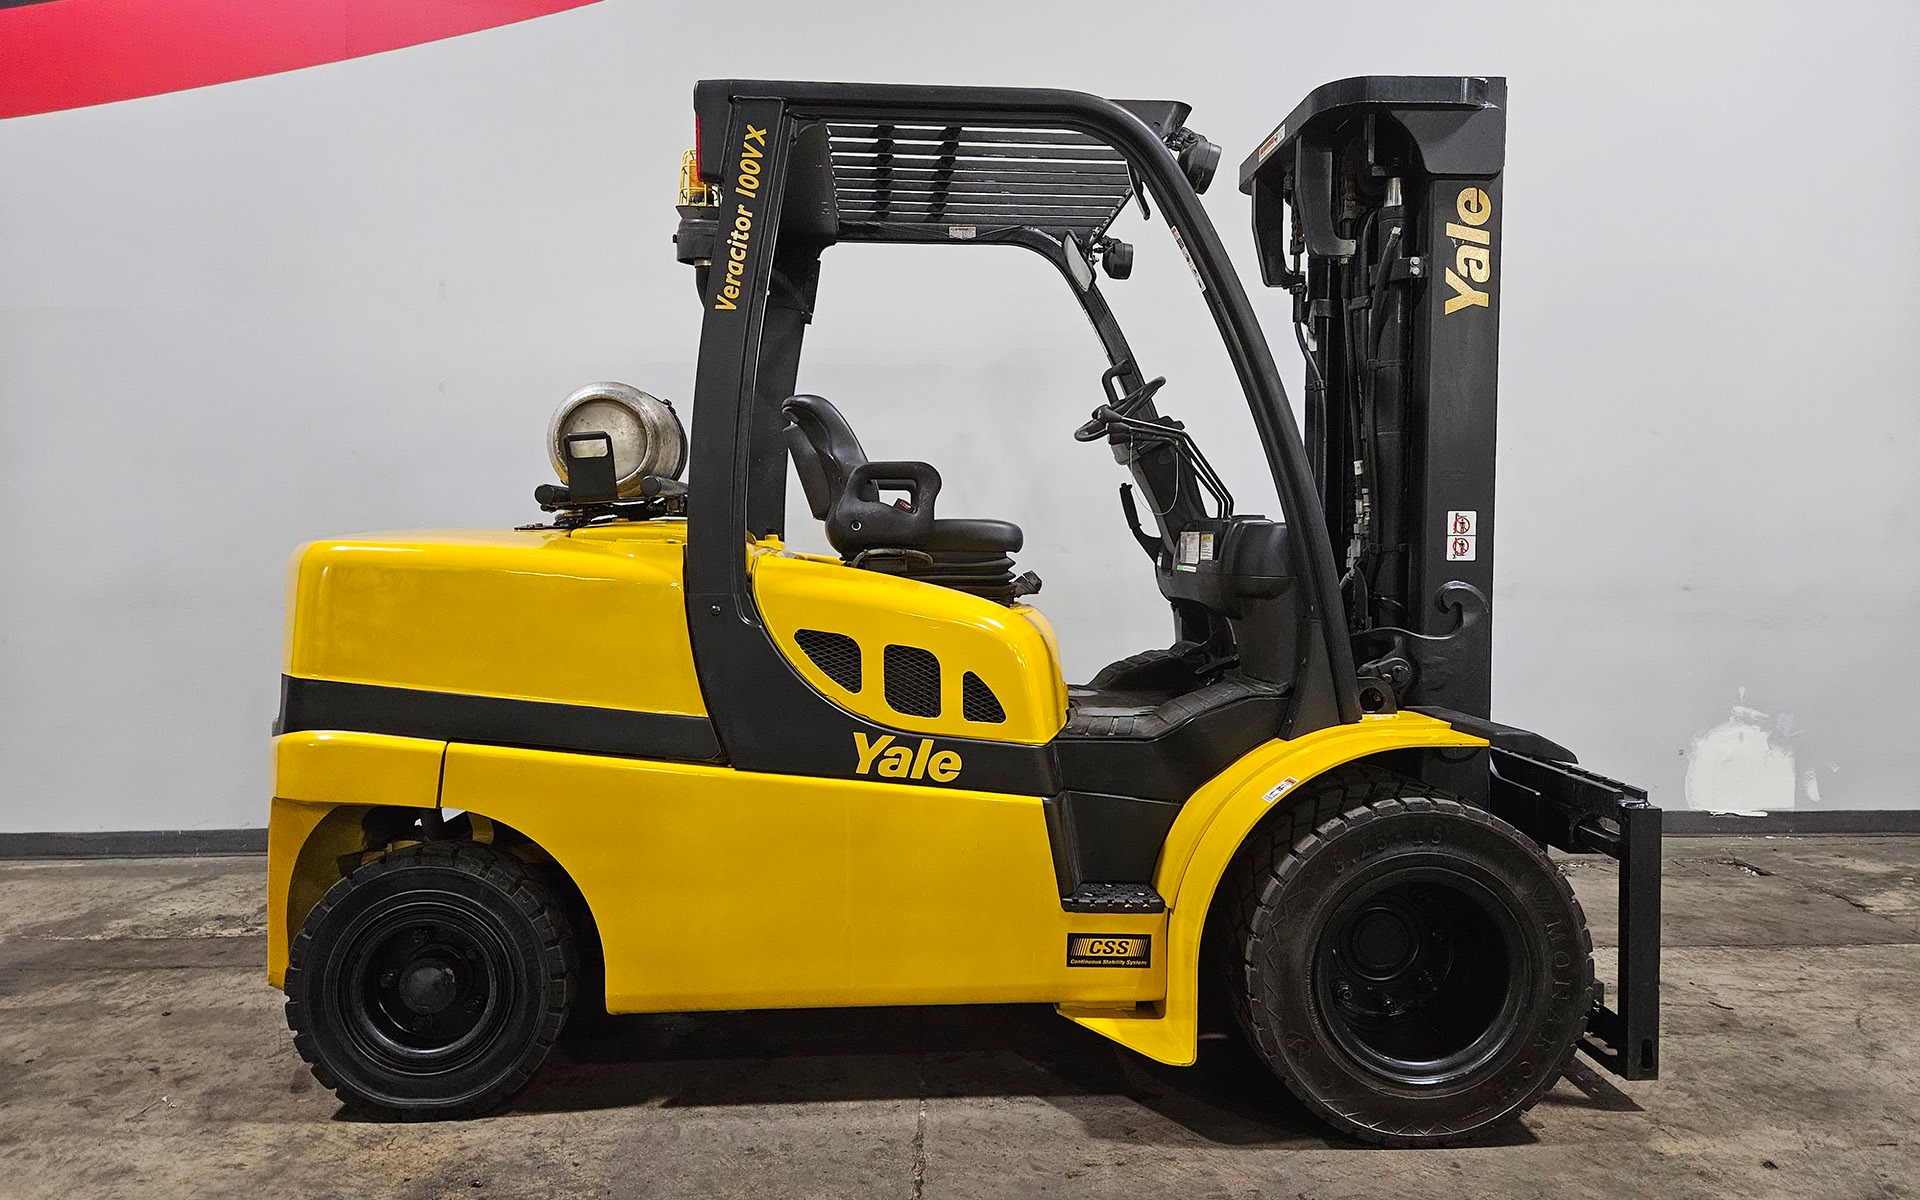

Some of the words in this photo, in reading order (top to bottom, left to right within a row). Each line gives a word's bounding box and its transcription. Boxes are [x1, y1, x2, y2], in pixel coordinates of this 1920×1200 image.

[714, 203, 752, 311] Veracitor
[735, 124, 767, 200] 100VX
[1444, 187, 1492, 315] Yale
[853, 731, 963, 783] Yale
[1089, 940, 1130, 955] CSS
